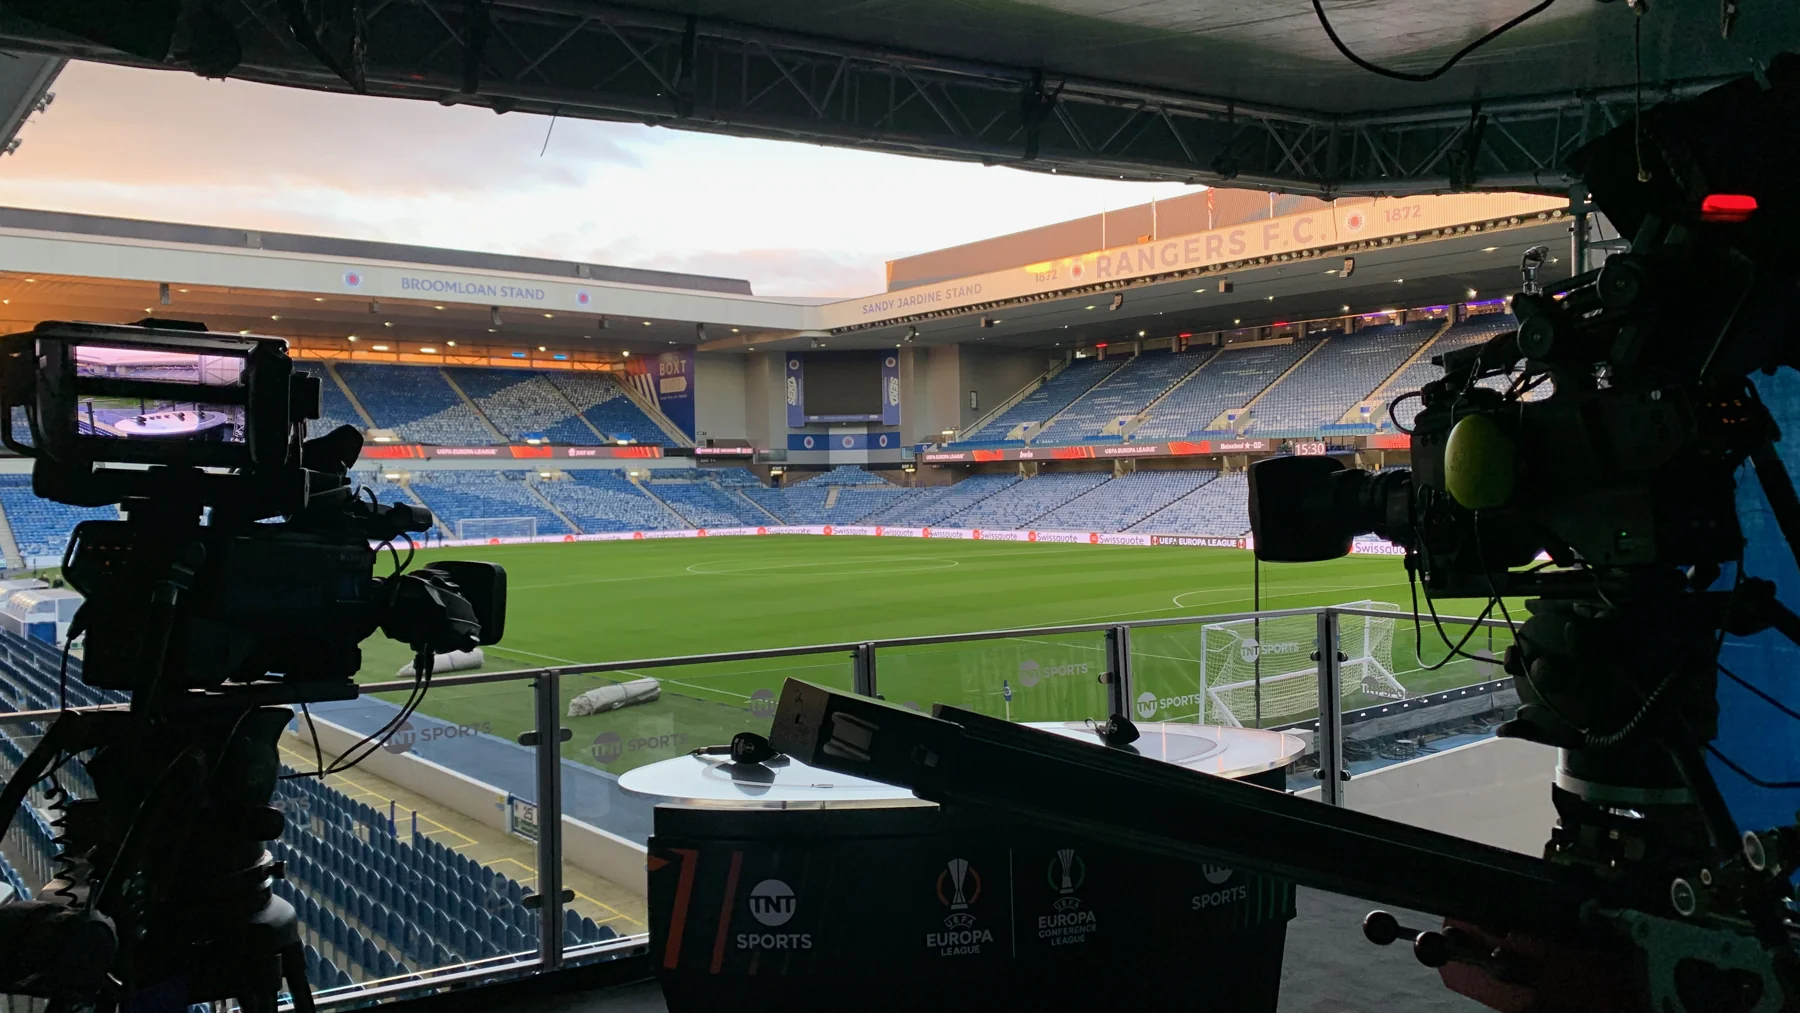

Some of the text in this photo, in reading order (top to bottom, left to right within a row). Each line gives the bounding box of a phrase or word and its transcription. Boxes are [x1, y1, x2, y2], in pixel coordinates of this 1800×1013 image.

[1385, 205, 1422, 222] 1872
[1096, 217, 1327, 279] RANGERS F.C.
[1035, 270, 1058, 283] 1872
[401, 277, 545, 300] BROOMLOAN STAND
[862, 284, 982, 315] SANDY JARDINE STAND
[660, 360, 687, 376] BOXT
[787, 376, 797, 406] SEKO
[889, 376, 899, 406] SEKO
[1295, 443, 1325, 455] 15:30
[1099, 534, 1144, 546] Swissquote
[1160, 537, 1237, 547] UEFA EUROPA LEAGUE
[1355, 542, 1407, 555] Swissquo
[1262, 642, 1299, 655] SPORTS
[1044, 663, 1088, 678] SPORTS
[1160, 693, 1201, 710] SPORTS
[421, 721, 492, 742] SPORTS
[627, 732, 690, 752] SPORTS
[1054, 898, 1080, 910] UEFA
[1191, 885, 1247, 911] SPORTS
[944, 916, 974, 928] UEFA
[1038, 910, 1097, 929] EUROPA
[926, 928, 994, 948] EUROPA
[1038, 924, 1097, 939] CONFERENCE
[736, 933, 813, 949] SPORTS
[1051, 934, 1086, 946] LEAGUE
[940, 945, 981, 957] LEAGUE
